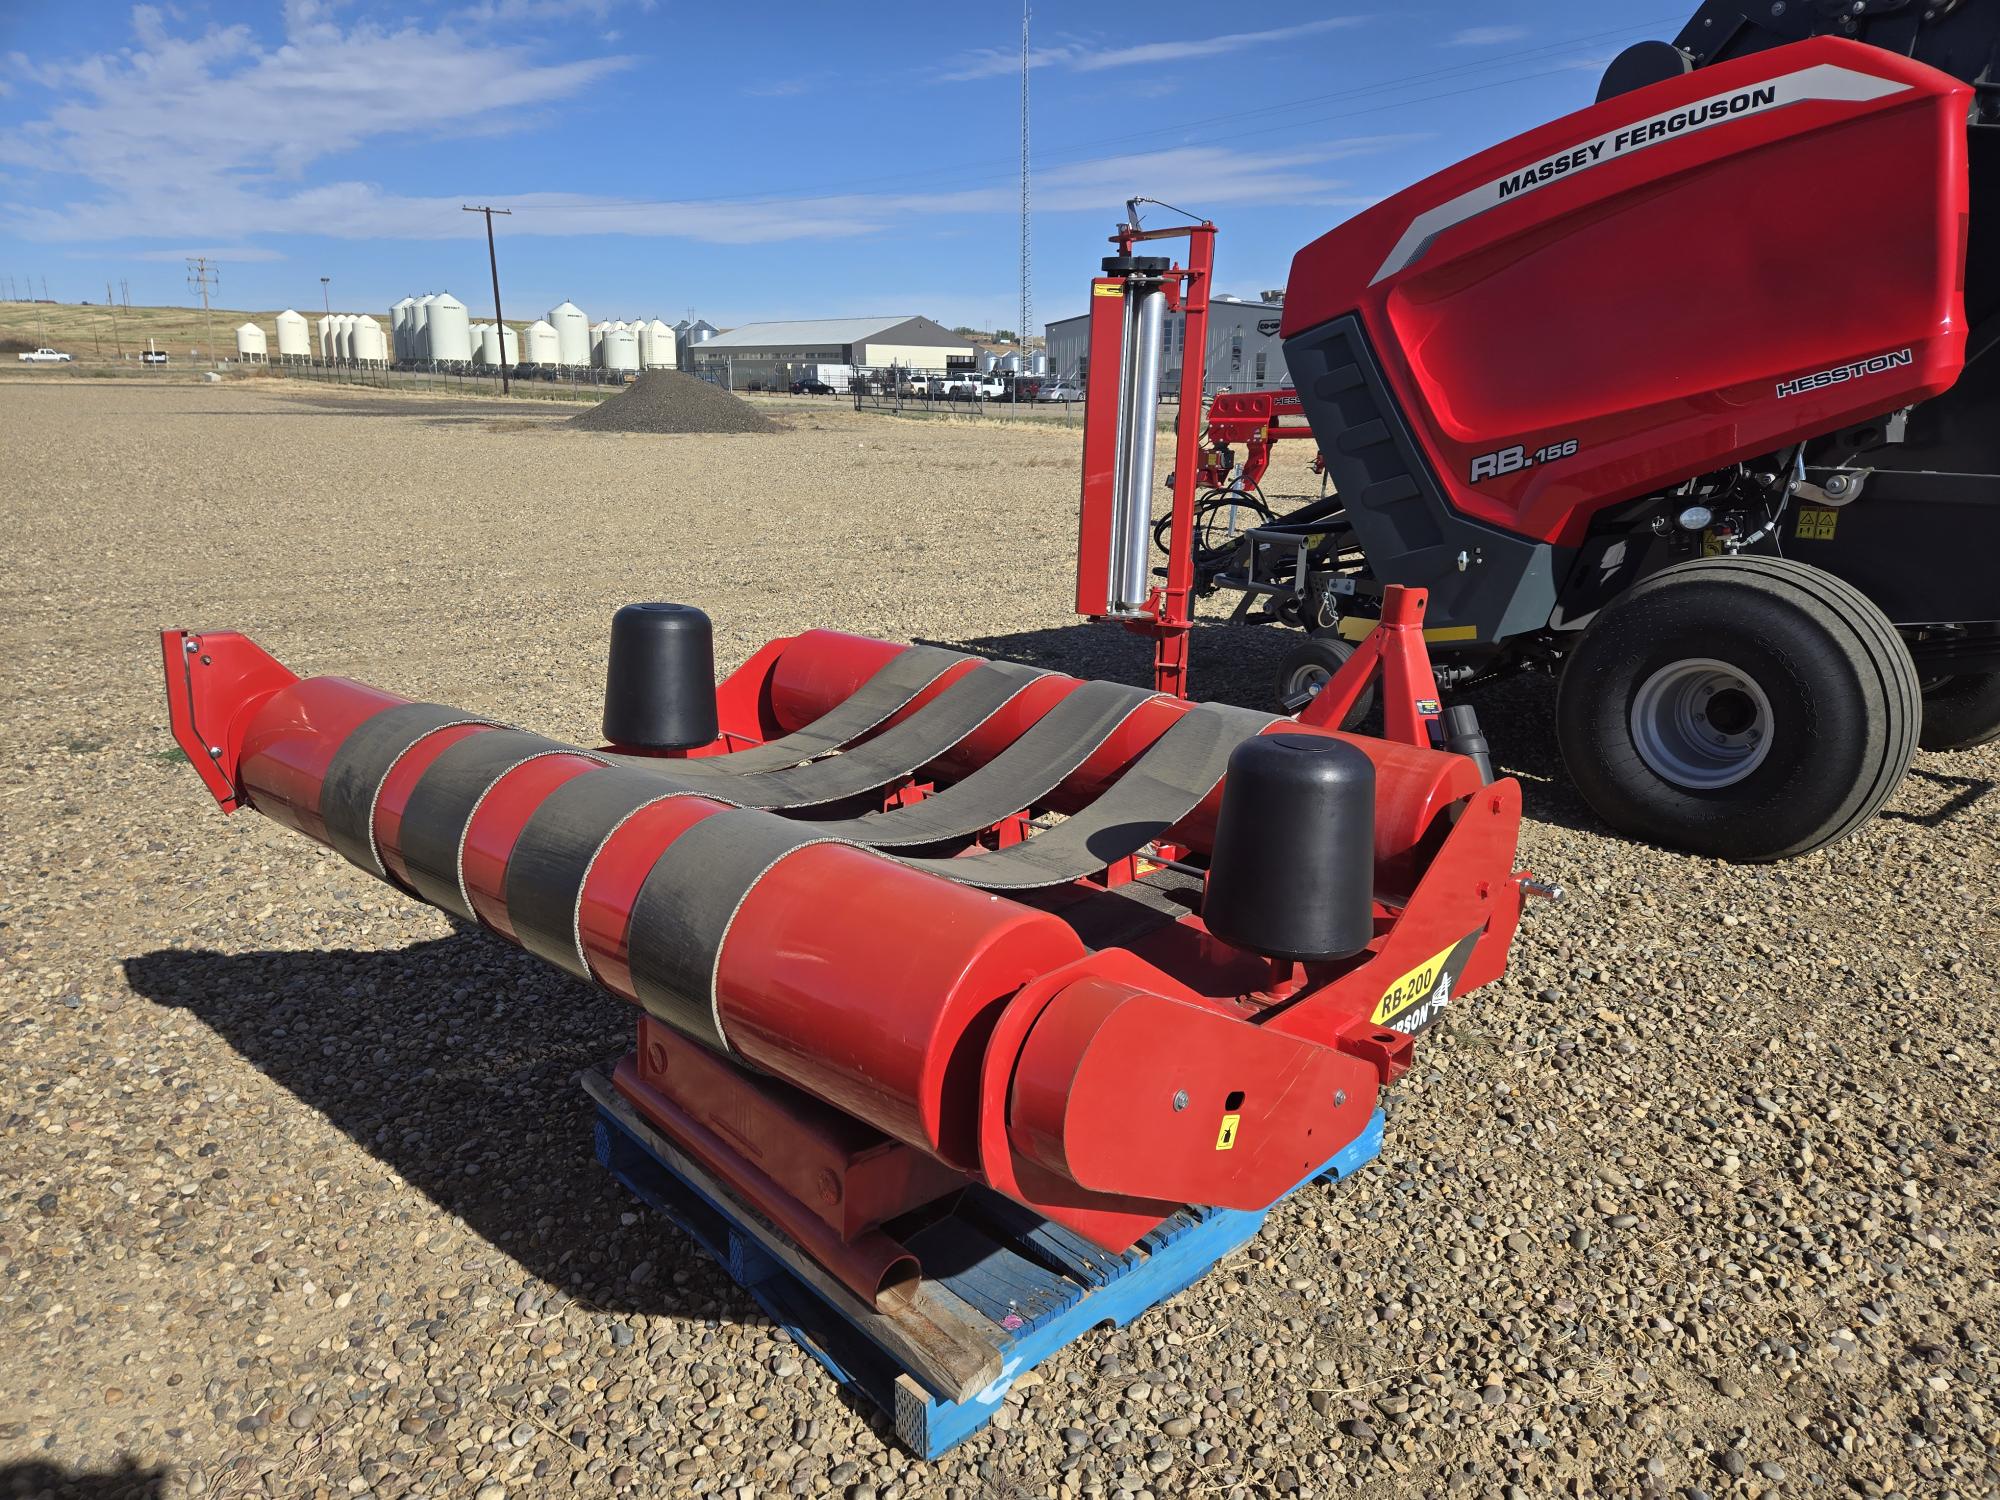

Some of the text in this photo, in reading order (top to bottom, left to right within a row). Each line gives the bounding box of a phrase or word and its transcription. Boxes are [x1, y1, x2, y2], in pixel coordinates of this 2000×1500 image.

[1498, 85, 1776, 199] MASSEY FERGUSON
[1776, 348, 1913, 399] HESSTON
[1381, 967, 1433, 1019] RB-200
